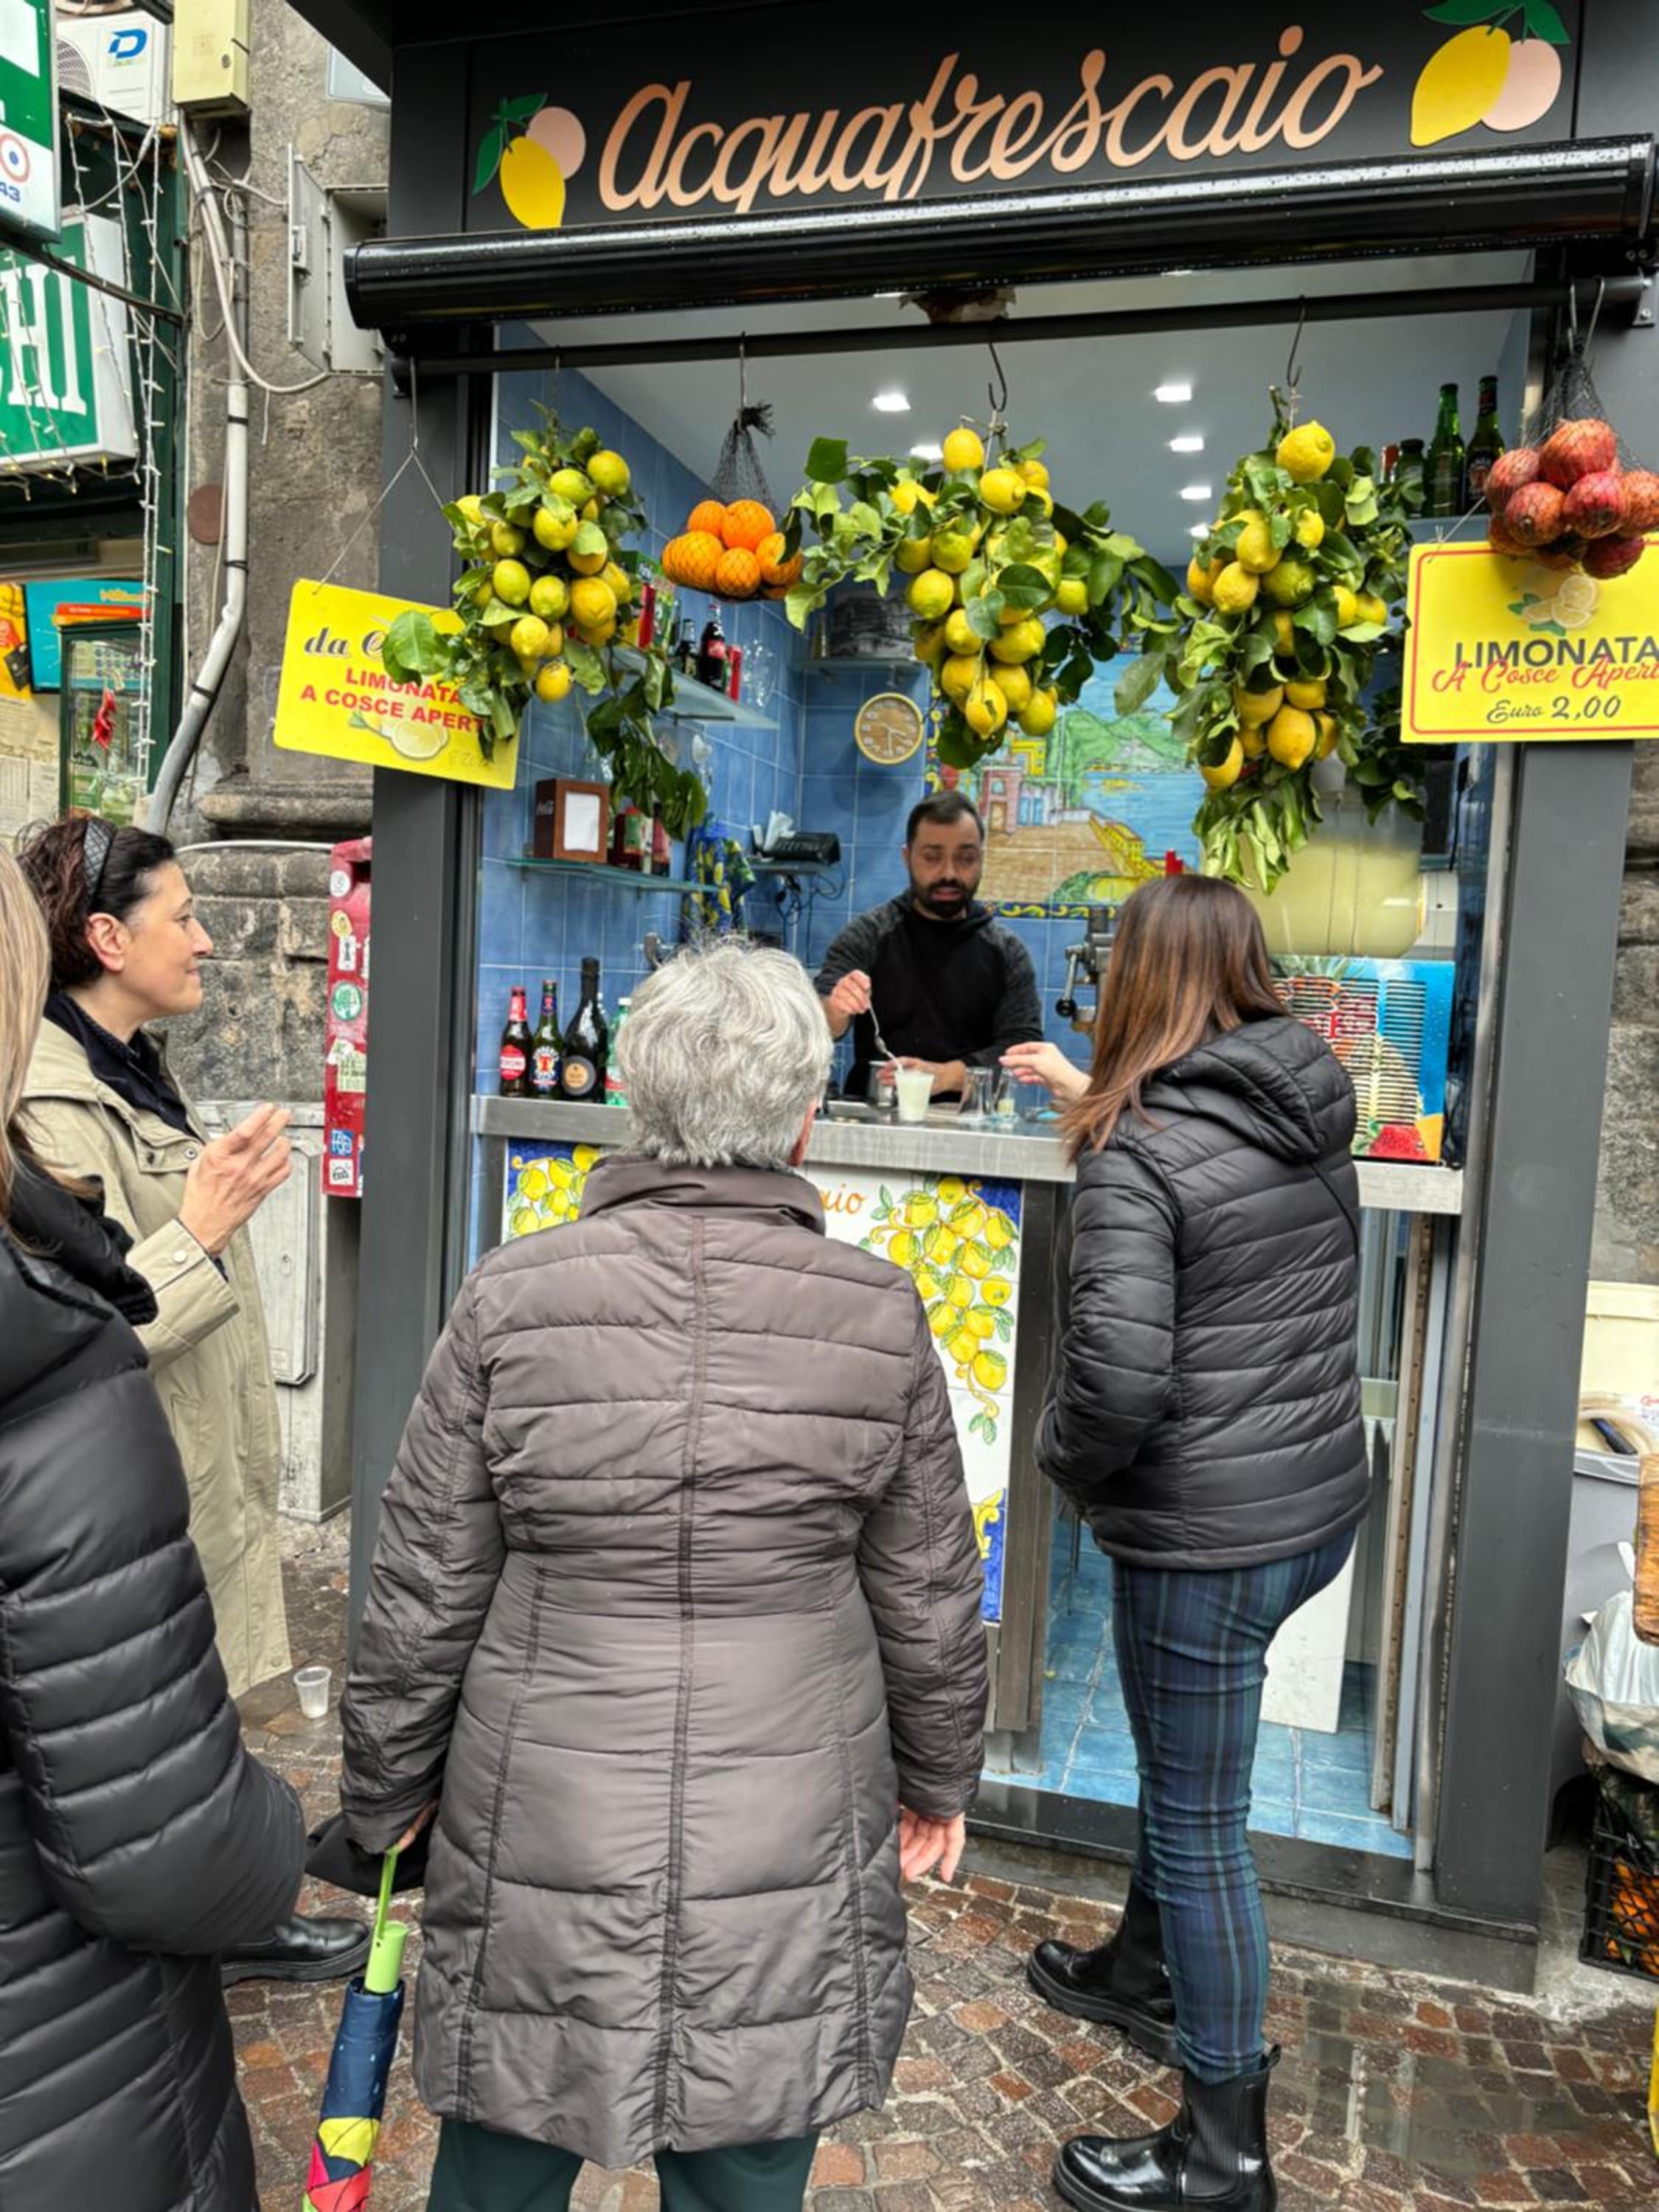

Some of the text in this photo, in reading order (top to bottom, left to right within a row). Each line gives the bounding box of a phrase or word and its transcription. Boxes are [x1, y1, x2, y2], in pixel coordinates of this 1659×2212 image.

[597, 24, 1383, 213] Acquafrescaio
[0, 255, 88, 416] HI
[304, 627, 349, 656] da
[1455, 635, 1659, 669] LIMONATA
[1432, 661, 1467, 692] A
[1481, 658, 1559, 693] Cosce
[301, 684, 316, 701] A
[325, 688, 404, 718] COSCE
[1486, 695, 1621, 723] Euro 2,00
